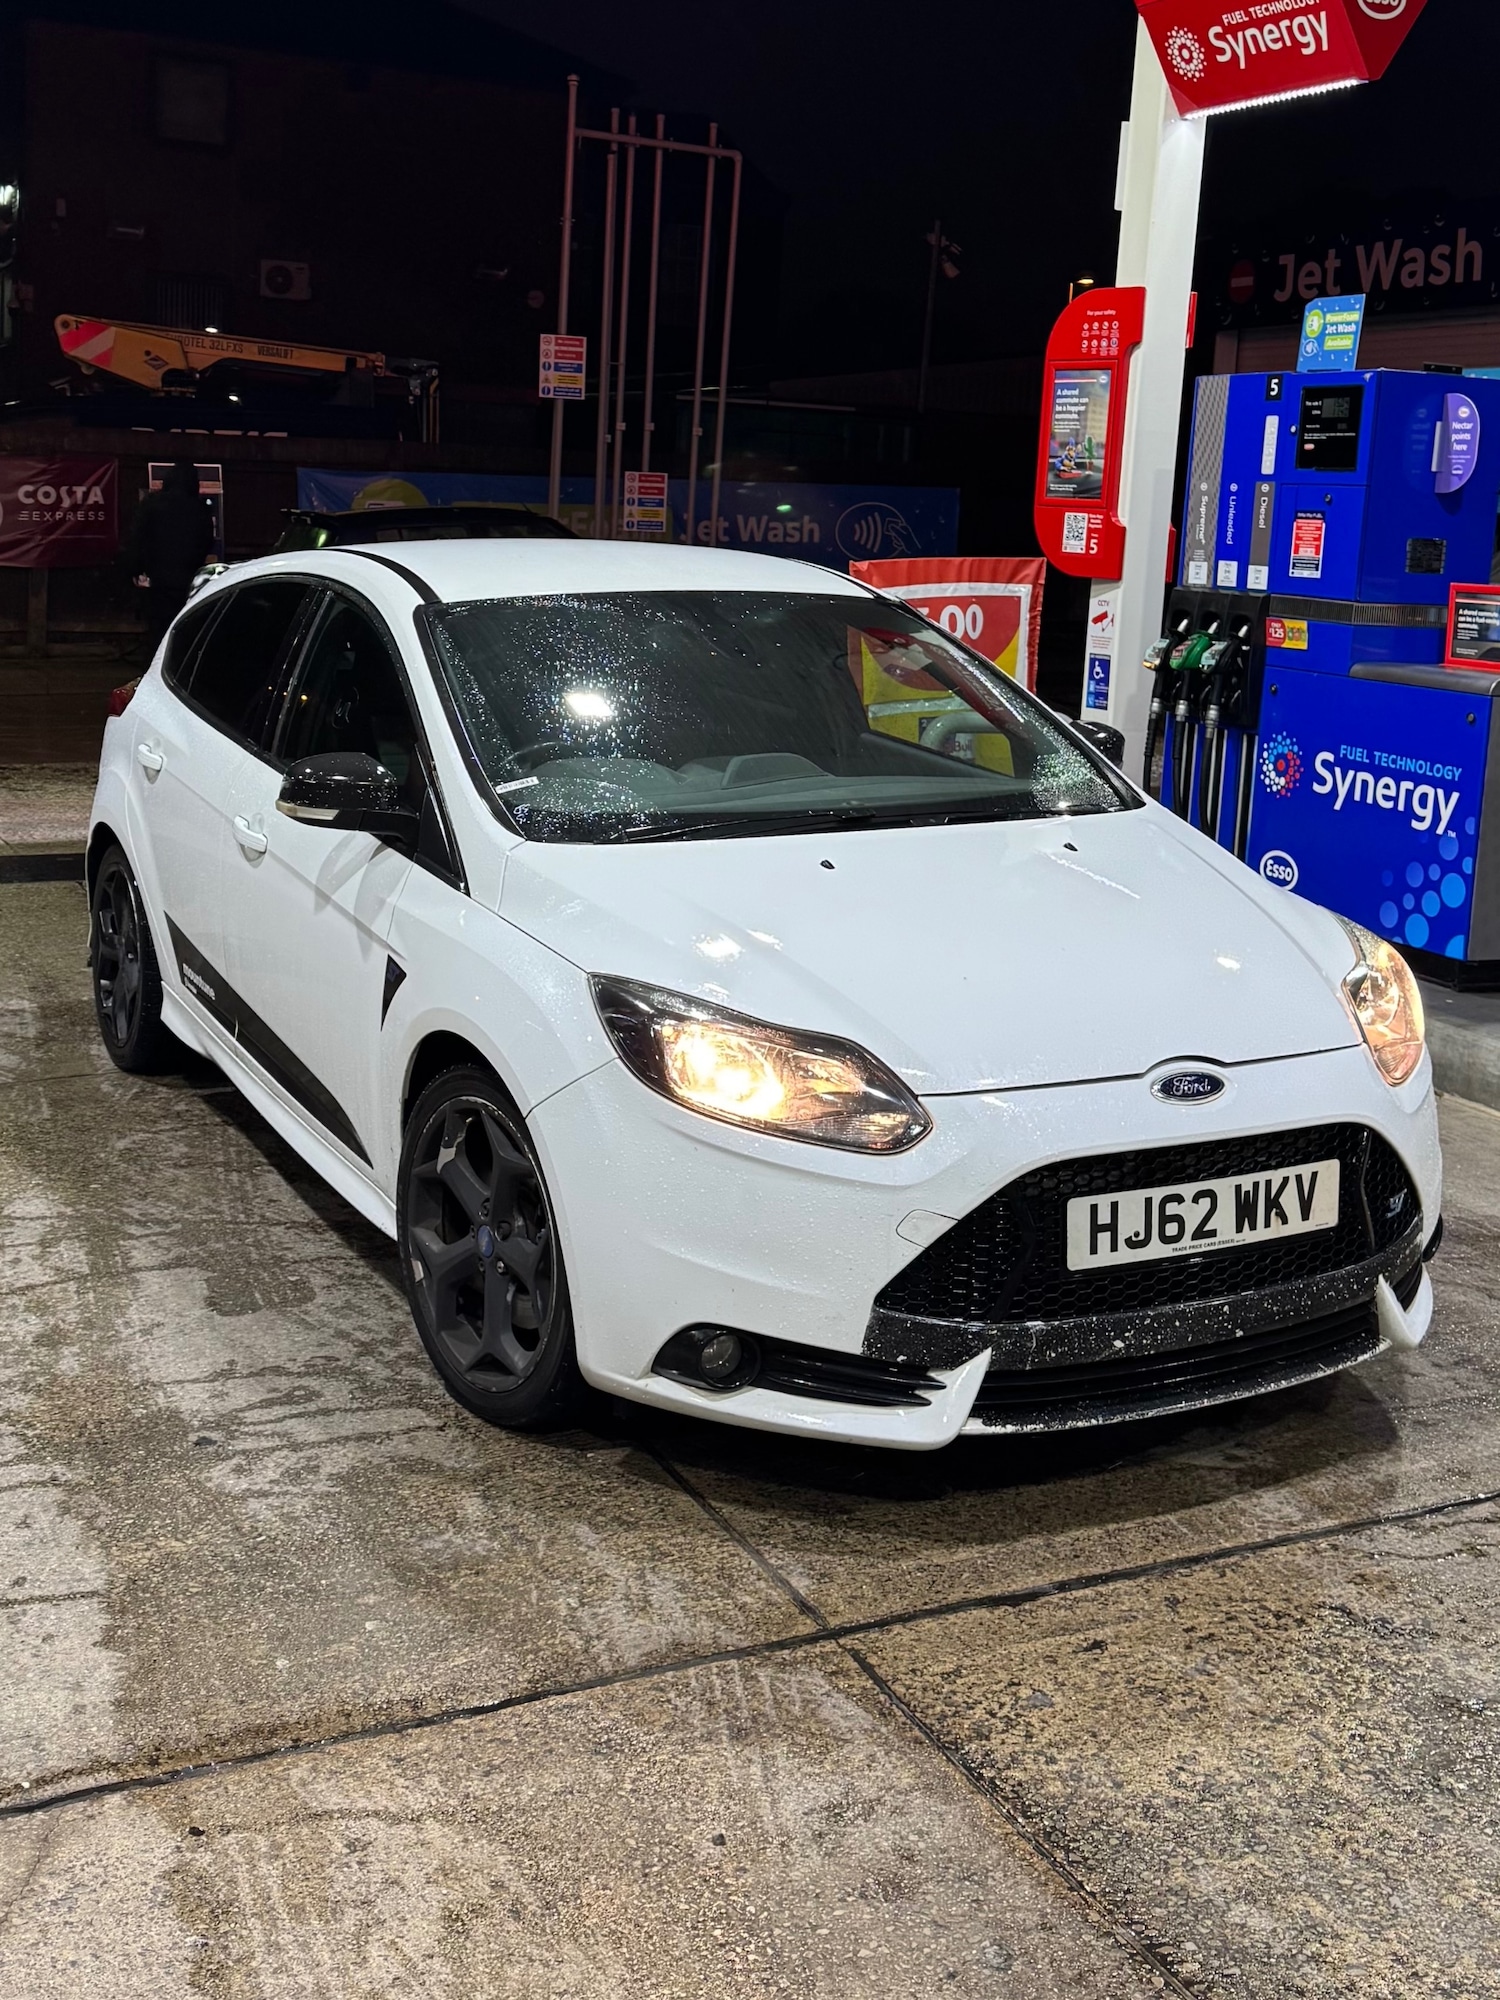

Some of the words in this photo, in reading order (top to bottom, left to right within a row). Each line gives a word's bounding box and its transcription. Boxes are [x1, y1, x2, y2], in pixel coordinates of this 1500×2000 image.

[1222, 10, 1249, 26] FUEL
[1207, 11, 1328, 69] Synergy
[1273, 248, 1342, 303] Jet
[1355, 227, 1483, 294] Wash
[1325, 324, 1337, 334] Jet
[1338, 323, 1356, 333] Wash
[209, 339, 243, 354] 32LFXS
[1270, 378, 1279, 396] 5
[1452, 421, 1474, 430] Nectar
[1452, 432, 1471, 442] points
[1453, 442, 1468, 451] here
[17, 484, 105, 508] COSTA
[32, 511, 105, 521] EXPRESS
[1226, 496, 1237, 545] Unleaded
[1258, 497, 1269, 529] Diesel
[738, 514, 821, 543] Wash
[1089, 538, 1099, 555] 5
[1339, 744, 1370, 767] FUEL
[1373, 751, 1463, 782] TECHNOLOGY
[1312, 751, 1461, 836] Synergy
[1265, 858, 1293, 882] Esso
[1172, 1076, 1211, 1096] Ford
[1089, 1188, 1219, 1256] HJ62
[1234, 1170, 1319, 1235] WKV
[1217, 1238, 1235, 1246] (ESSEX)
